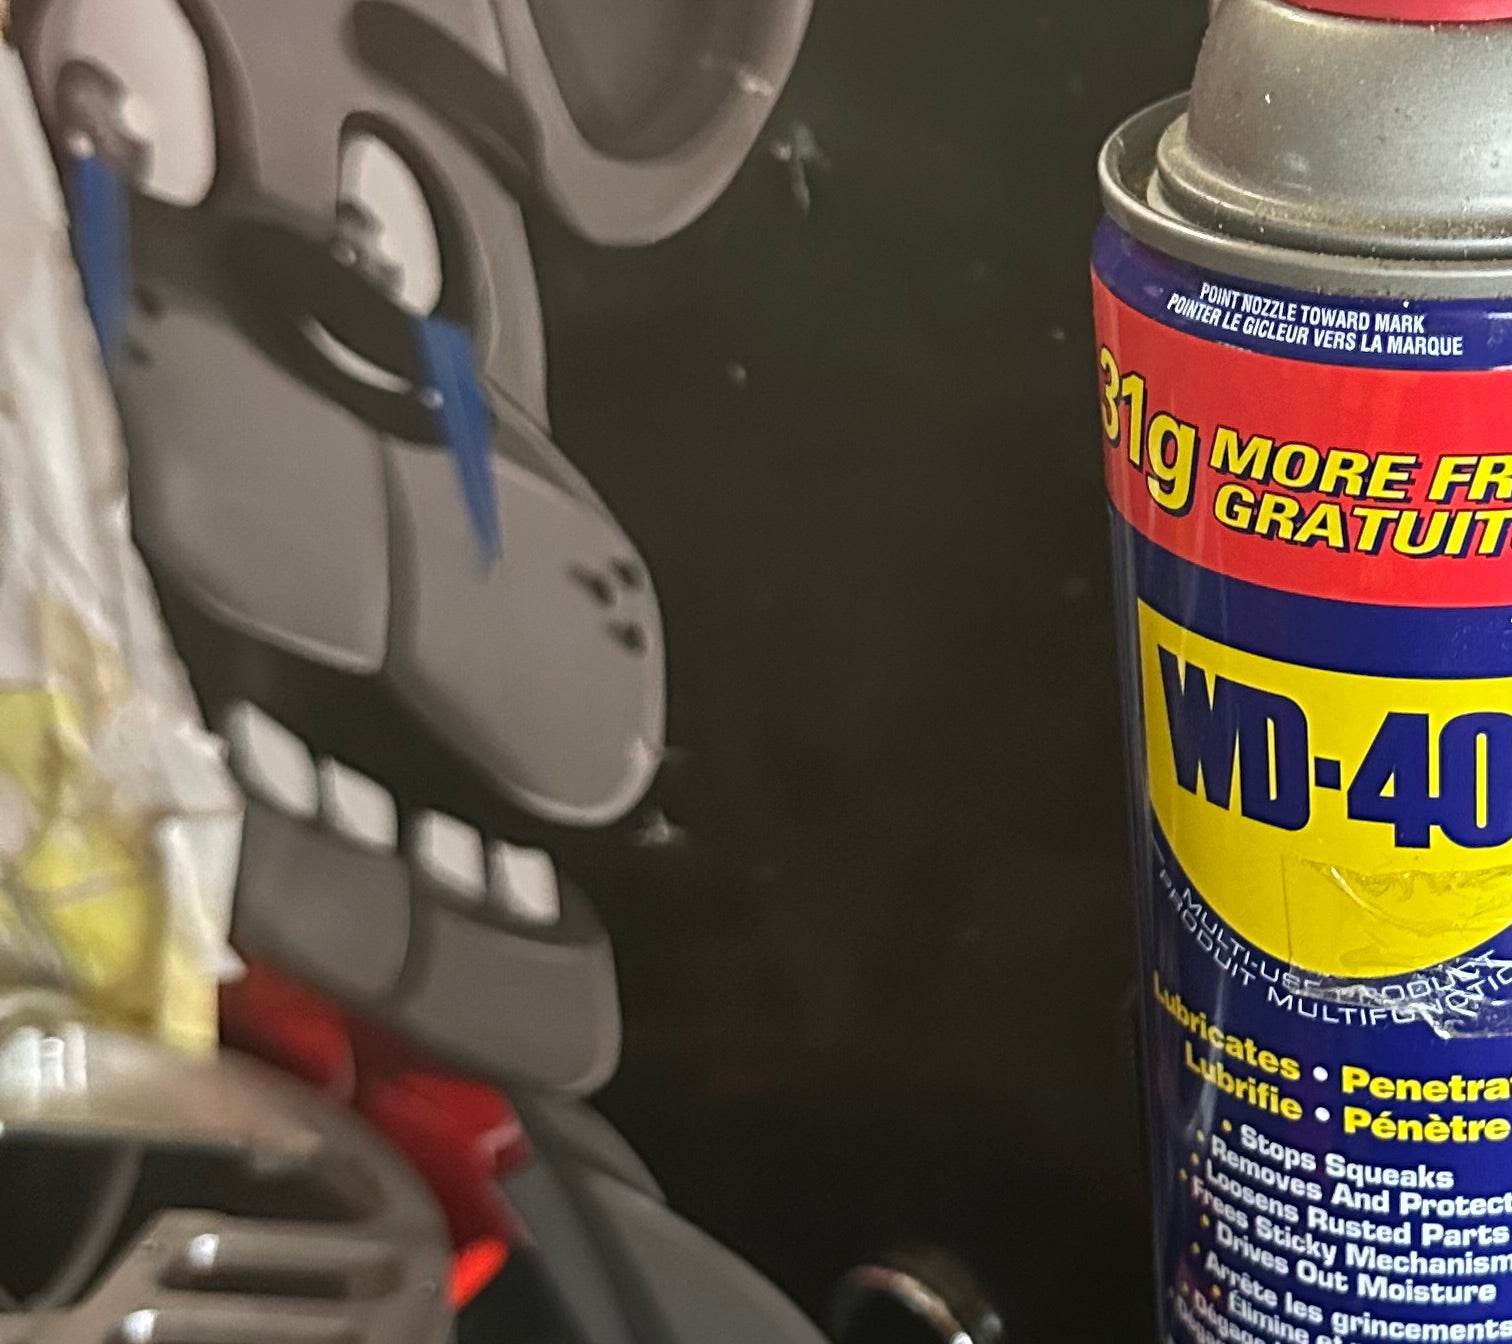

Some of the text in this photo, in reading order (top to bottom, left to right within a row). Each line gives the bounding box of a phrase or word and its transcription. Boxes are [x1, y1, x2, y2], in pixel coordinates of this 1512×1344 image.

[1167, 293, 1463, 356] POINTER LE GICLEUR VERS LA MARQUE
[1200, 282, 1425, 334] POINT NOZZLE TOWARD MARK
[1099, 346, 1200, 516] 31g
[1209, 425, 1422, 503] MORE
[1159, 867, 1258, 988] PRODUIT
[1154, 971, 1301, 1081] Lubricates
[1185, 1040, 1512, 1143] Lubrifie Pénètre
[1211, 1134, 1323, 1201] Removes
[1331, 1182, 1389, 1213] And
[1240, 1124, 1454, 1190] Stops Squeaks
[1190, 1175, 1249, 1229] Frees
[1254, 1215, 1338, 1268] Sticky
[1206, 1158, 1511, 1247] Loosens Rusted Parts
[1205, 1251, 1278, 1308] Arrête
[1284, 1291, 1324, 1325] les
[1215, 1220, 1497, 1304] Drives Out Moisture
